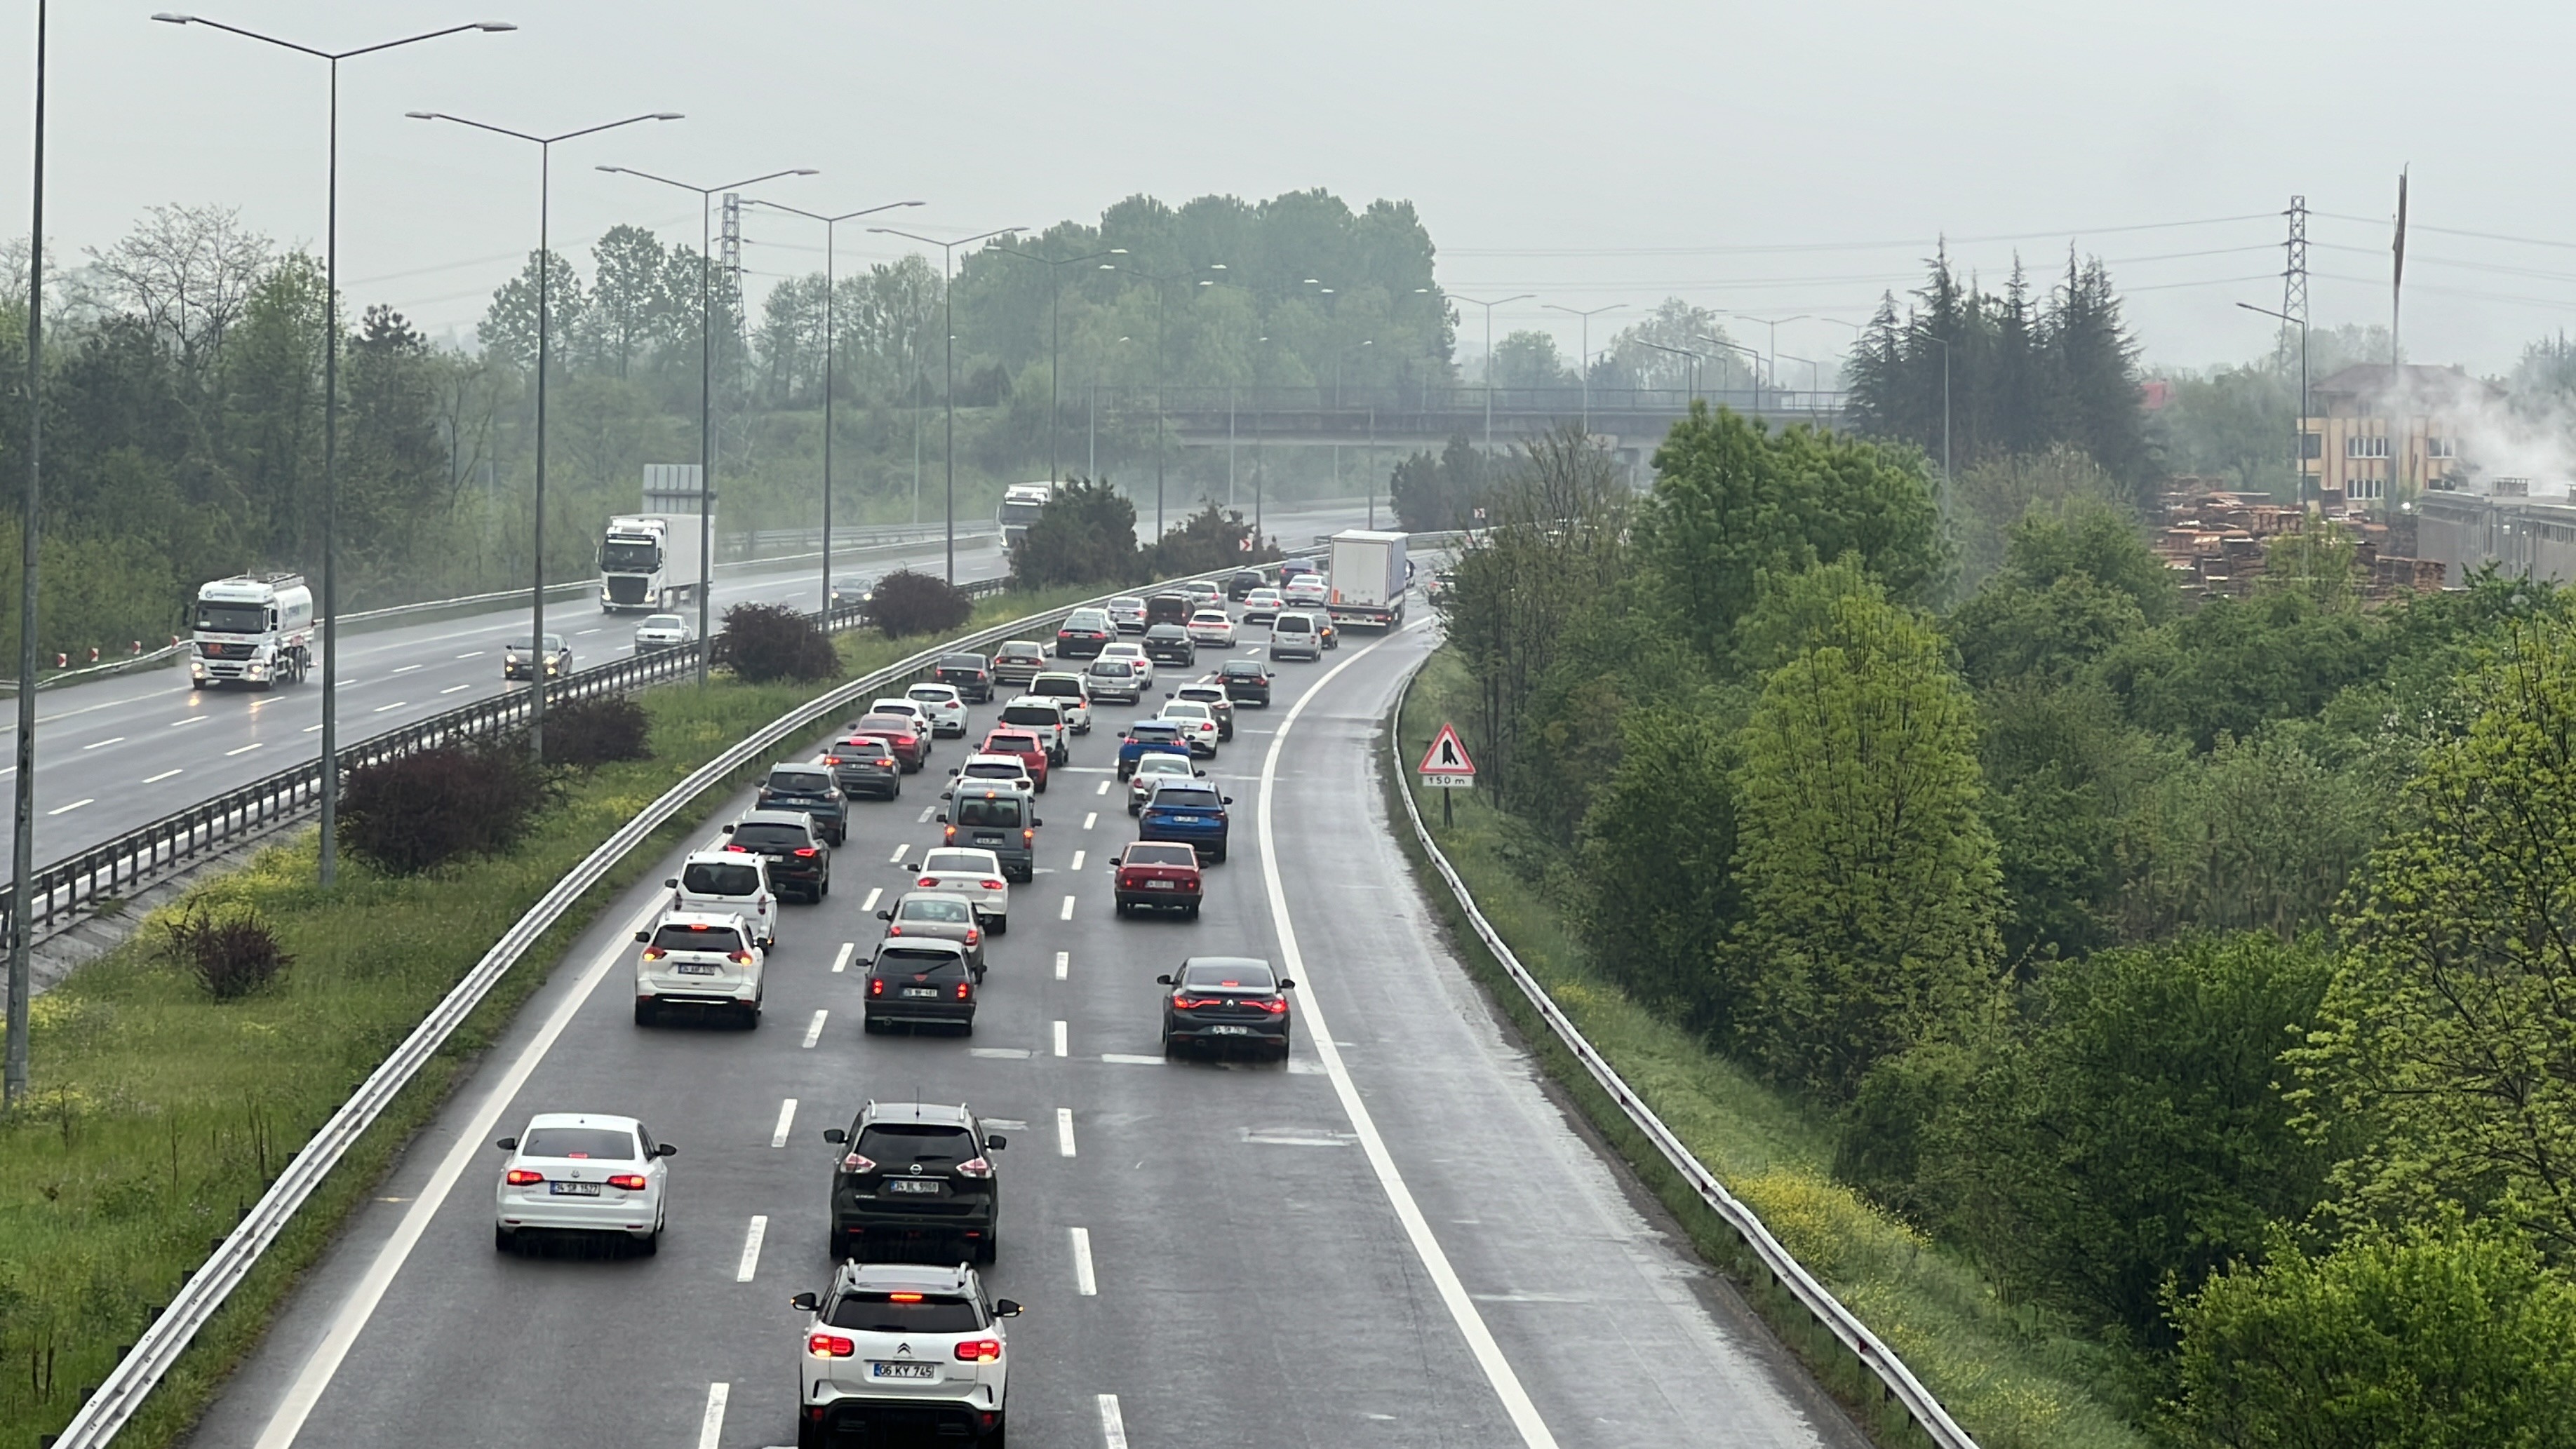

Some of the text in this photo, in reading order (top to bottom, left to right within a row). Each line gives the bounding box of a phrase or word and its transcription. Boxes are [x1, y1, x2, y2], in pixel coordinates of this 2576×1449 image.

[1429, 776, 1451, 784] 150
[896, 1182, 904, 1190] 34
[880, 1366, 932, 1377] 06 KY 745
